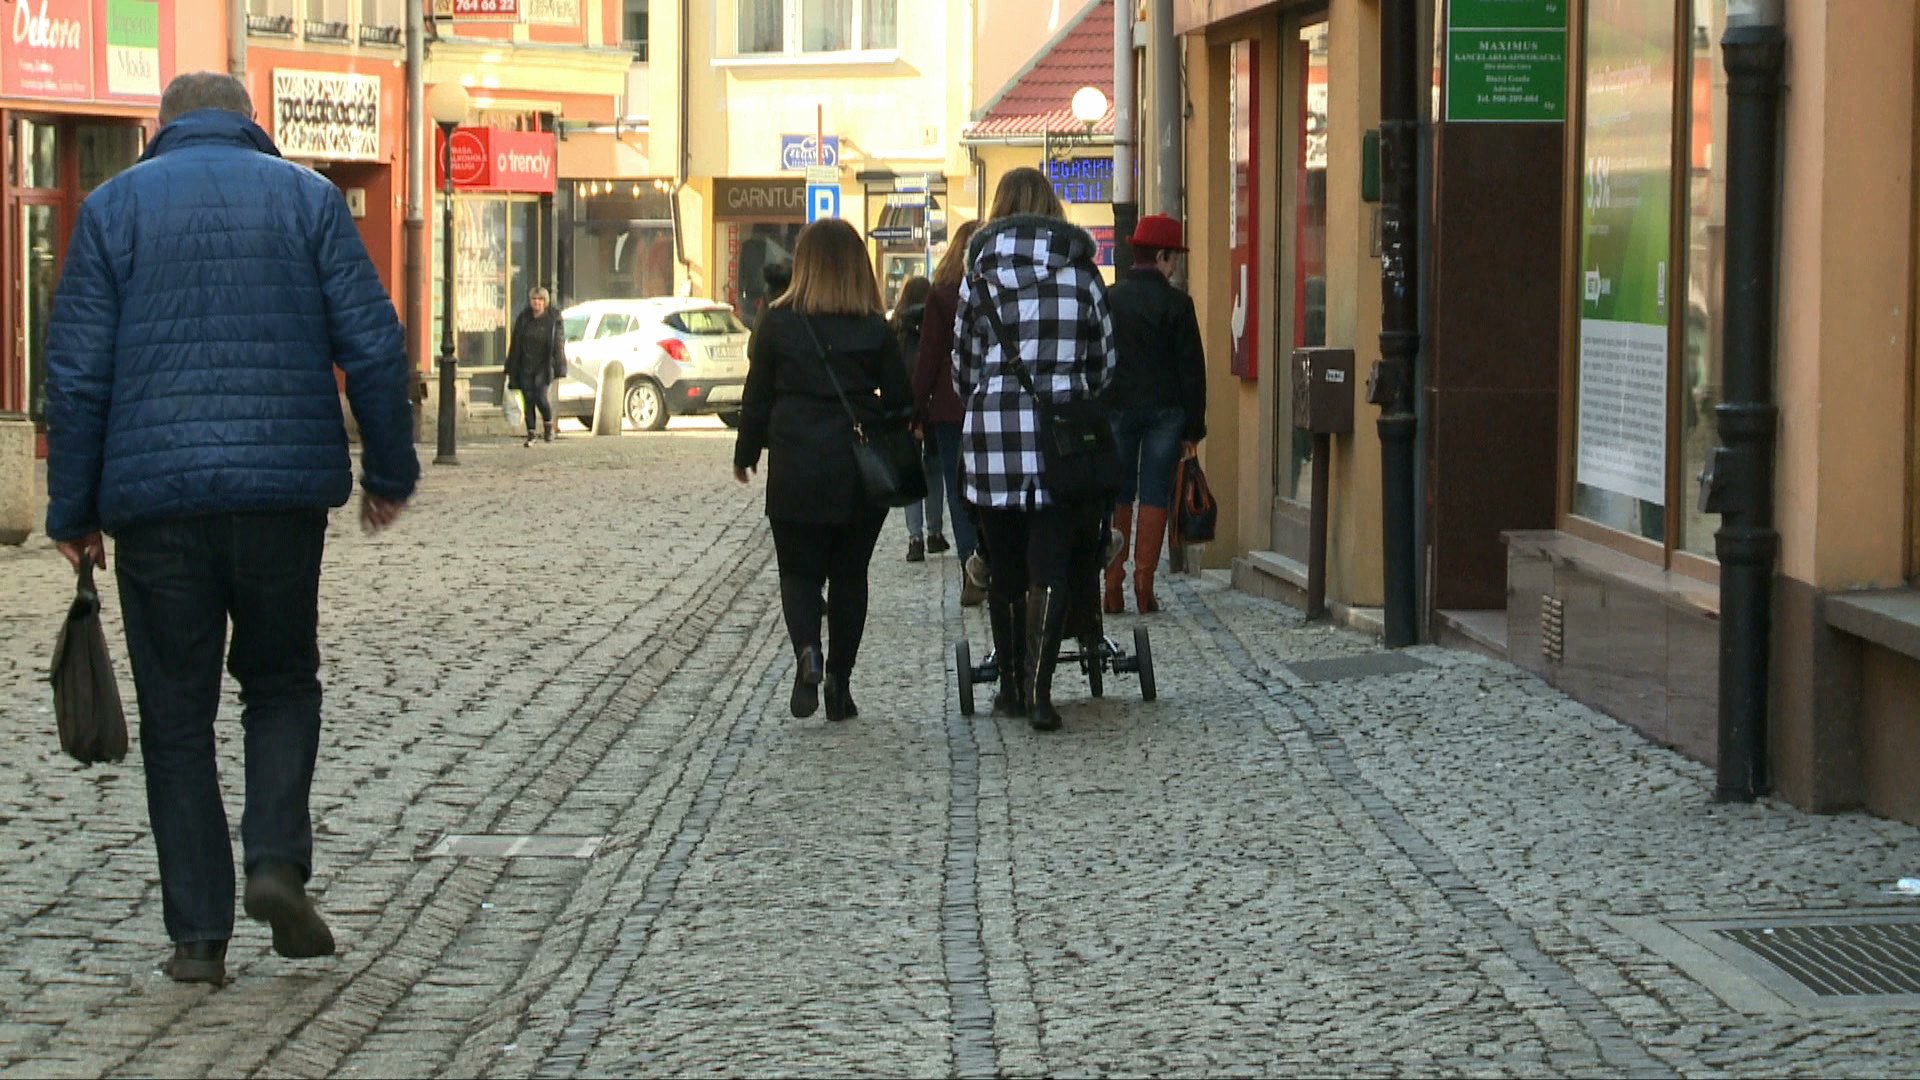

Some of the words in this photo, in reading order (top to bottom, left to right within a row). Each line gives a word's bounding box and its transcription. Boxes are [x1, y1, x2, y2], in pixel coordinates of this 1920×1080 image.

[13, 0, 81, 49] Dekora
[1455, 53, 1507, 62] KANCELARIA
[1479, 41, 1538, 51] MAXIMUS
[497, 153, 507, 172] o
[508, 148, 551, 179] trendy
[815, 189, 834, 220] P
